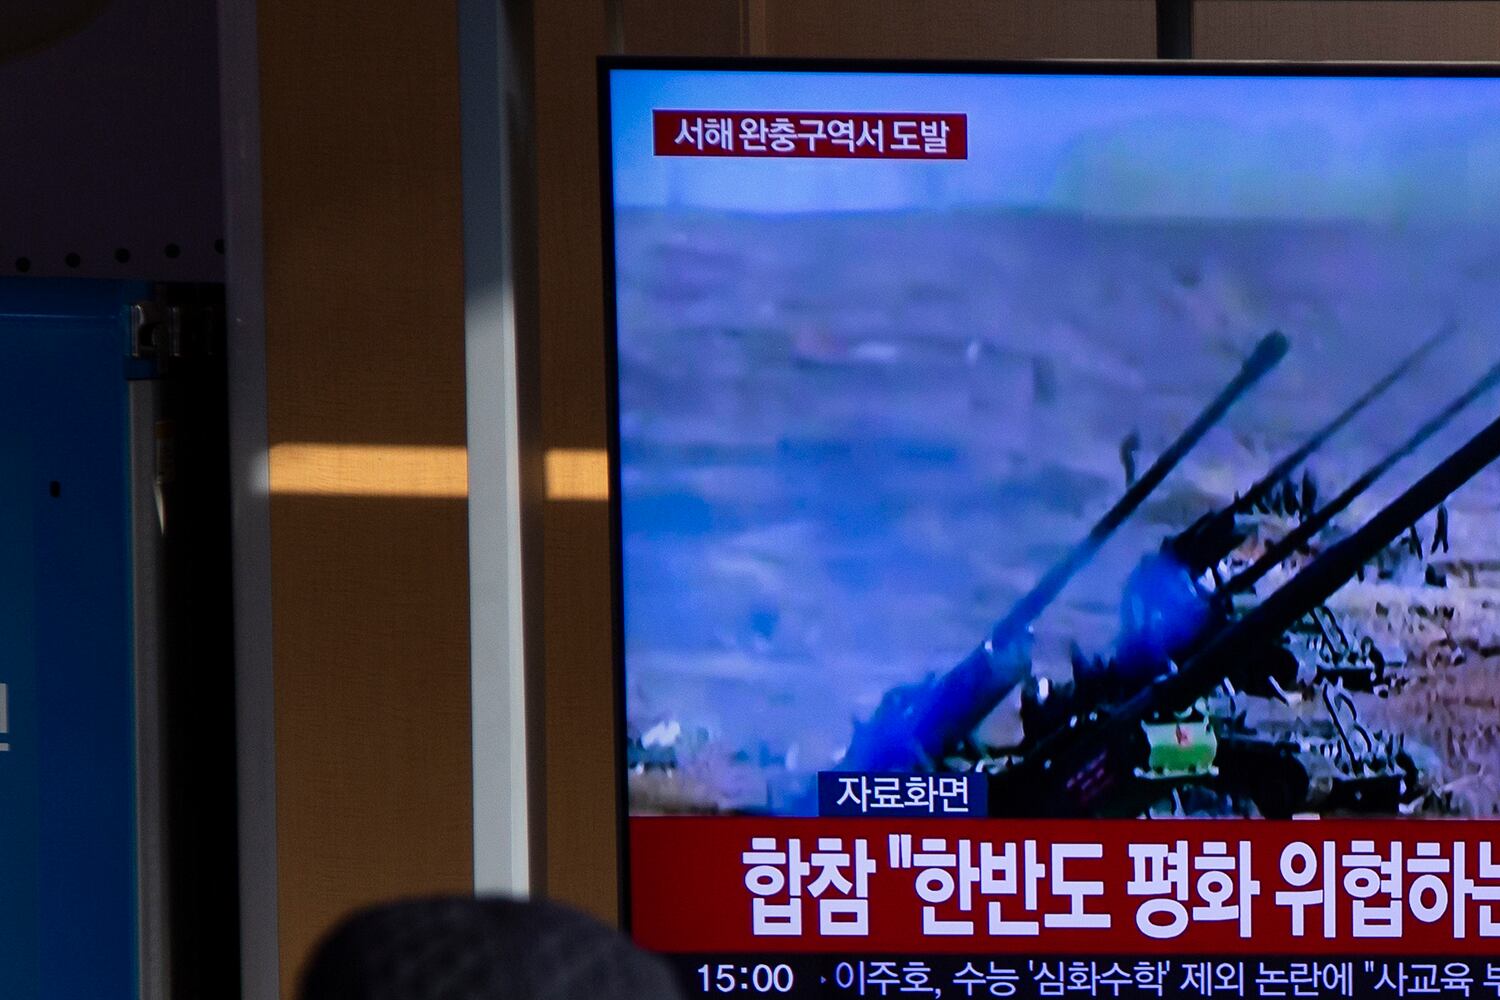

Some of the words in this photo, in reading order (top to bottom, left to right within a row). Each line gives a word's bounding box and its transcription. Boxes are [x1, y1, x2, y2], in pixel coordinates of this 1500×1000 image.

[675, 118, 732, 150] 서해
[739, 118, 883, 152] 완충구역서
[891, 121, 949, 152] 도발
[837, 776, 968, 812] 자료화면
[743, 838, 876, 935] 합참
[889, 834, 1111, 935] "한반도
[1128, 841, 1260, 938] 평화
[698, 964, 793, 992] 15:00
[837, 961, 941, 998] 이주호,
[953, 962, 1019, 996] 수능
[1030, 960, 1170, 996] '심화수학'
[1181, 962, 1243, 996] 제외
[1256, 962, 1352, 996] 논란에
[1365, 961, 1473, 997] "사교육
